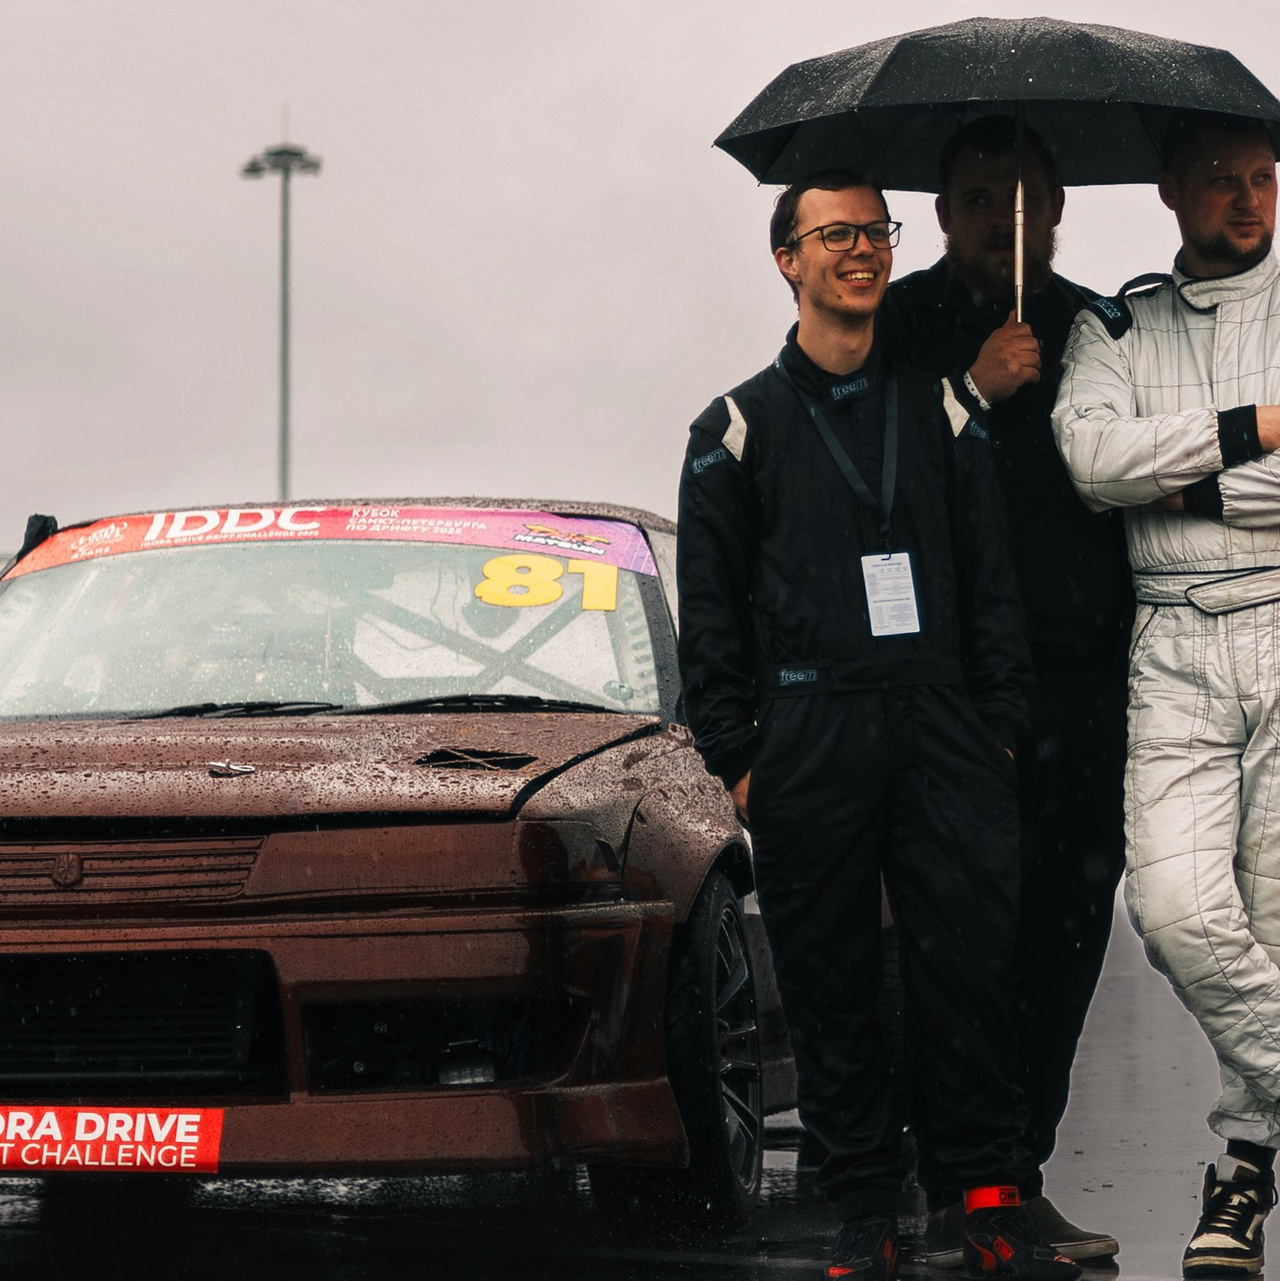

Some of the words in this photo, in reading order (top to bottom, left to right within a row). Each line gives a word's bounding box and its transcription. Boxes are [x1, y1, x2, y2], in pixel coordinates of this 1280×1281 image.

[832, 379, 866, 400] freem
[692, 449, 725, 473] freem
[144, 507, 322, 541] IDDC
[351, 508, 399, 518] КУБОК
[474, 553, 618, 611] 81
[780, 671, 816, 682] freem
[0, 1111, 62, 1142] RA
[75, 1112, 201, 1143] DRIVE
[21, 1143, 197, 1167] CHALLENGE
